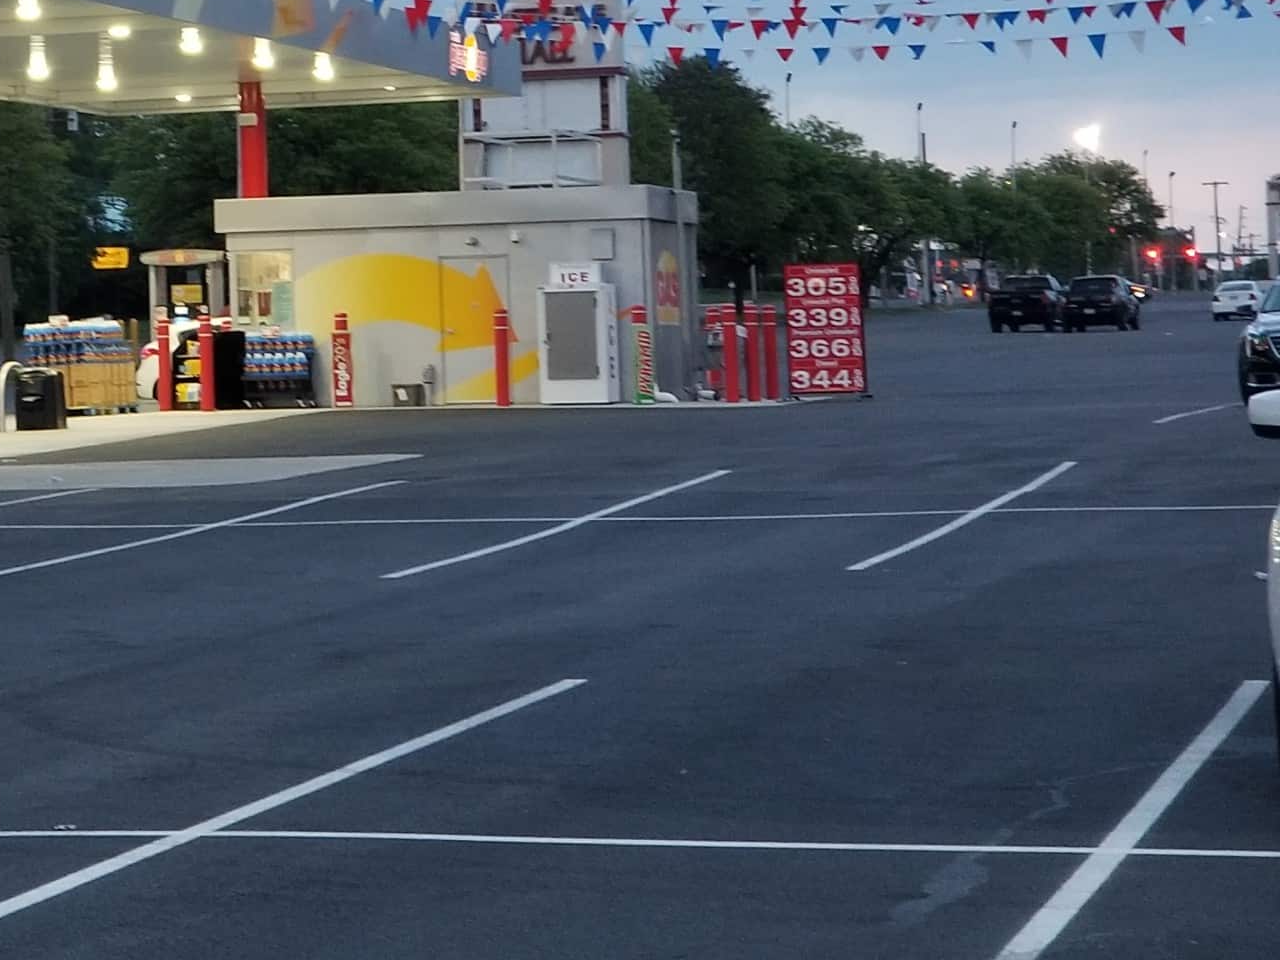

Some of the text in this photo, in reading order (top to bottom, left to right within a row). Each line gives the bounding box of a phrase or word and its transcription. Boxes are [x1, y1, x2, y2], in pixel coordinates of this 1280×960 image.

[561, 271, 590, 283] ICE
[786, 277, 847, 297] 305
[788, 308, 848, 327] 339
[789, 338, 850, 358] 366
[638, 330, 654, 395] PYRAMID
[791, 370, 852, 389] 344
